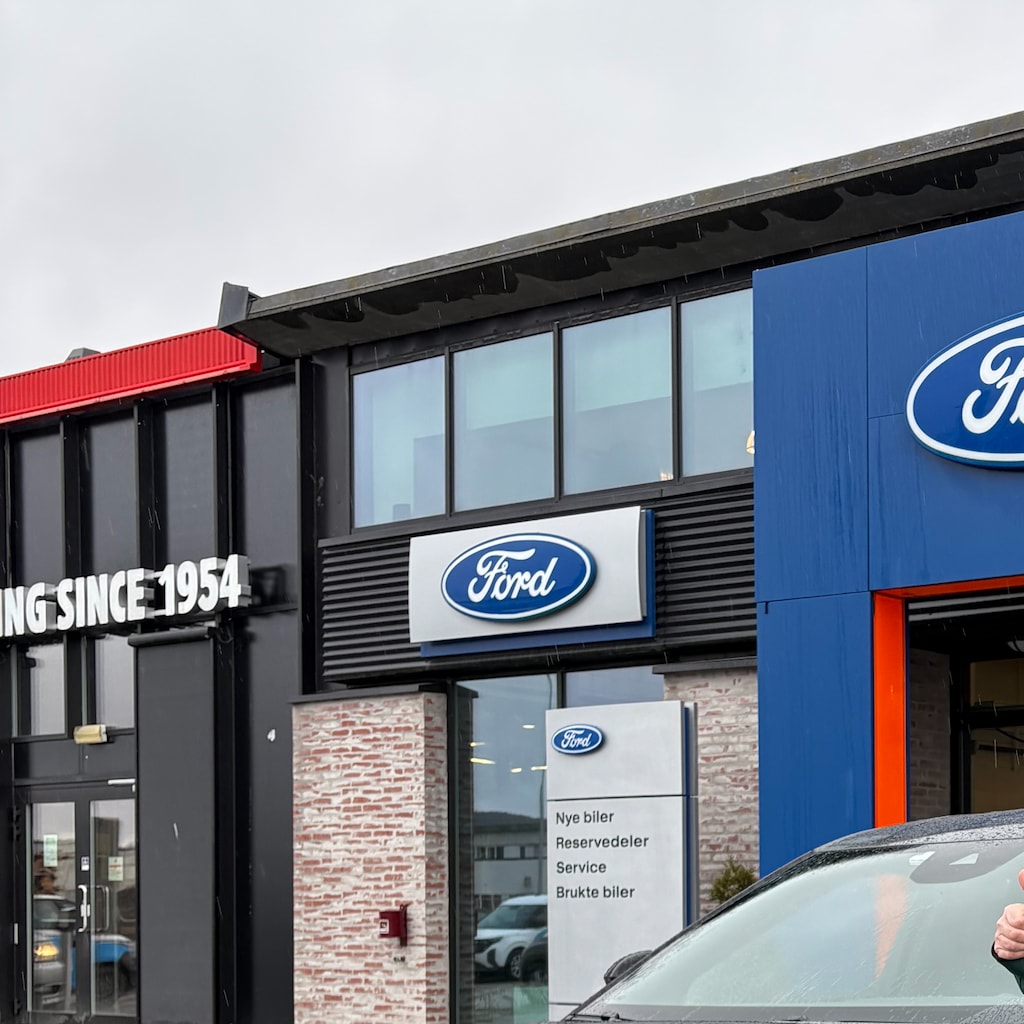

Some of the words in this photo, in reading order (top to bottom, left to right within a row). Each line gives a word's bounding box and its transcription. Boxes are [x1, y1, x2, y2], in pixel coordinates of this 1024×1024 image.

[467, 548, 559, 603] Ford
[56, 567, 147, 631] SINCE
[158, 553, 242, 617] 1954
[560, 729, 592, 749] Ford
[555, 812, 581, 828] Nye
[583, 811, 615, 824] biler
[555, 835, 650, 850] Reservedeler
[556, 861, 608, 874] Service
[556, 886, 600, 899] Brukte
[602, 885, 636, 899] biler
